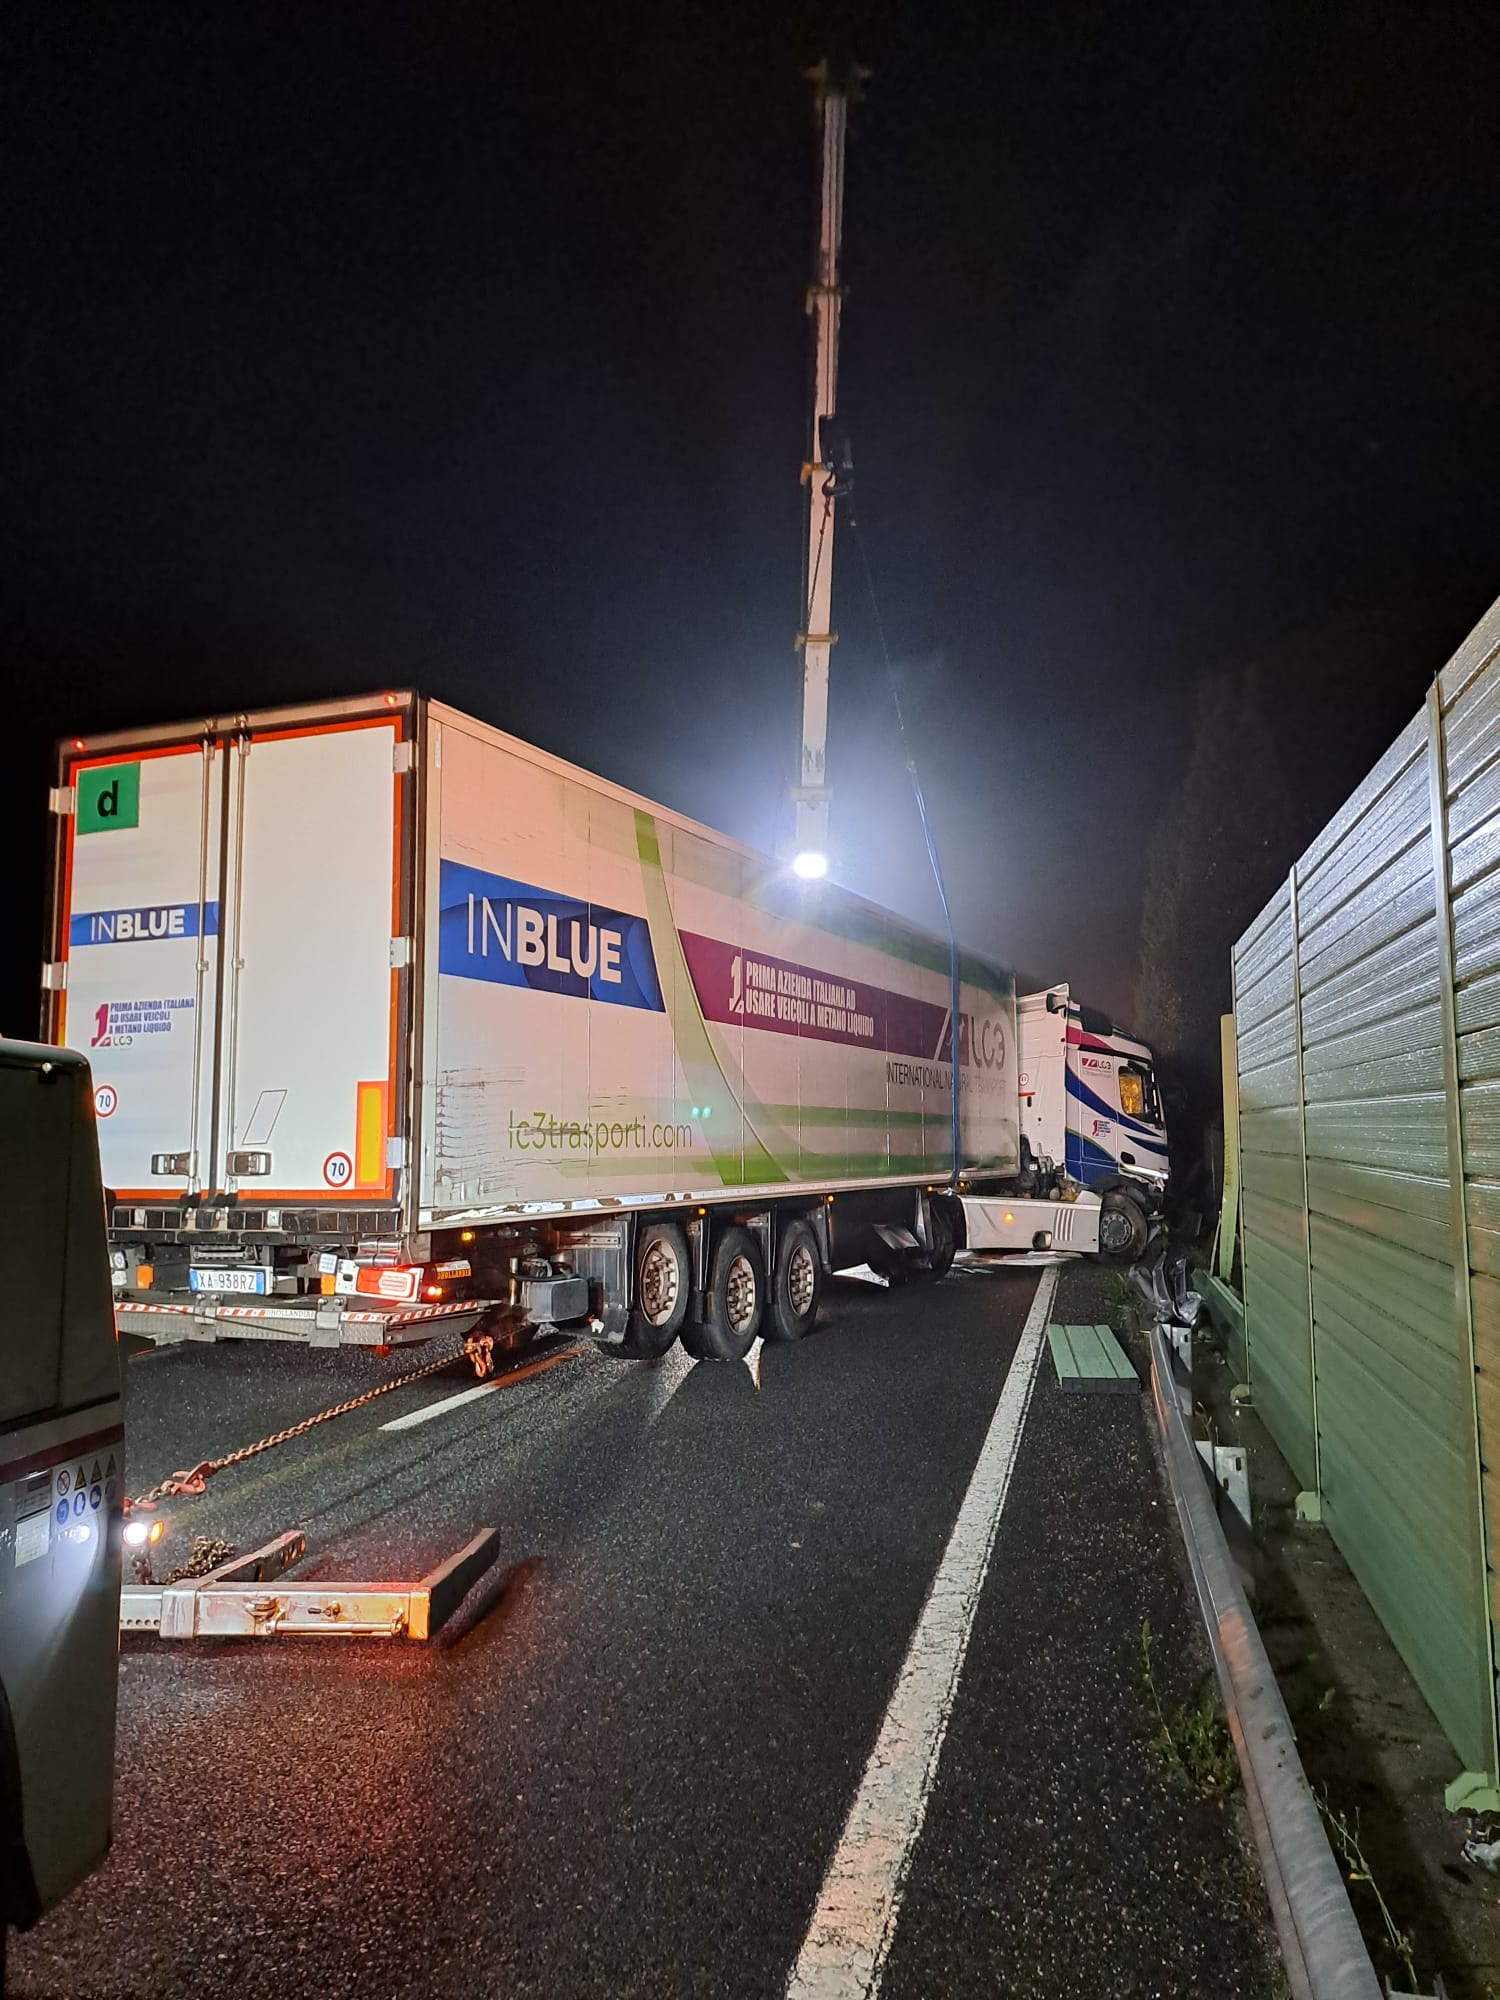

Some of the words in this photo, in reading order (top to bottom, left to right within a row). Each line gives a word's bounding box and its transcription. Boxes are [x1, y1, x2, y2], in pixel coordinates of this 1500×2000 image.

[97, 780, 119, 817] d
[90, 908, 185, 942] INBLUE
[468, 892, 622, 984] INBLUE
[746, 961, 776, 992] PRIMA
[777, 970, 812, 1000] AZIENDA
[813, 979, 846, 1008] ITALIANA
[846, 988, 856, 1011] AD
[109, 1014, 119, 1023] AD
[120, 1012, 142, 1023] USARE
[143, 1011, 171, 1021] VEICOLI
[110, 1002, 133, 1012] PRIMA
[133, 1000, 162, 1011] AZIENDA
[163, 998, 195, 1009] ITALIANA
[745, 988, 775, 1018] USARE
[777, 995, 809, 1024] VEICOLI
[810, 1004, 816, 1026] A
[817, 1005, 847, 1033] METANO
[847, 1010, 874, 1038] LIQUIDO
[108, 1025, 113, 1034] A
[114, 1023, 142, 1034] METANO
[143, 1022, 172, 1033] LIQUIDO
[886, 1062, 943, 1090] INTERNATIONAL
[99, 1094, 111, 1108] 70
[508, 1109, 692, 1156] lc3trasporti.com
[331, 1162, 345, 1177] 70
